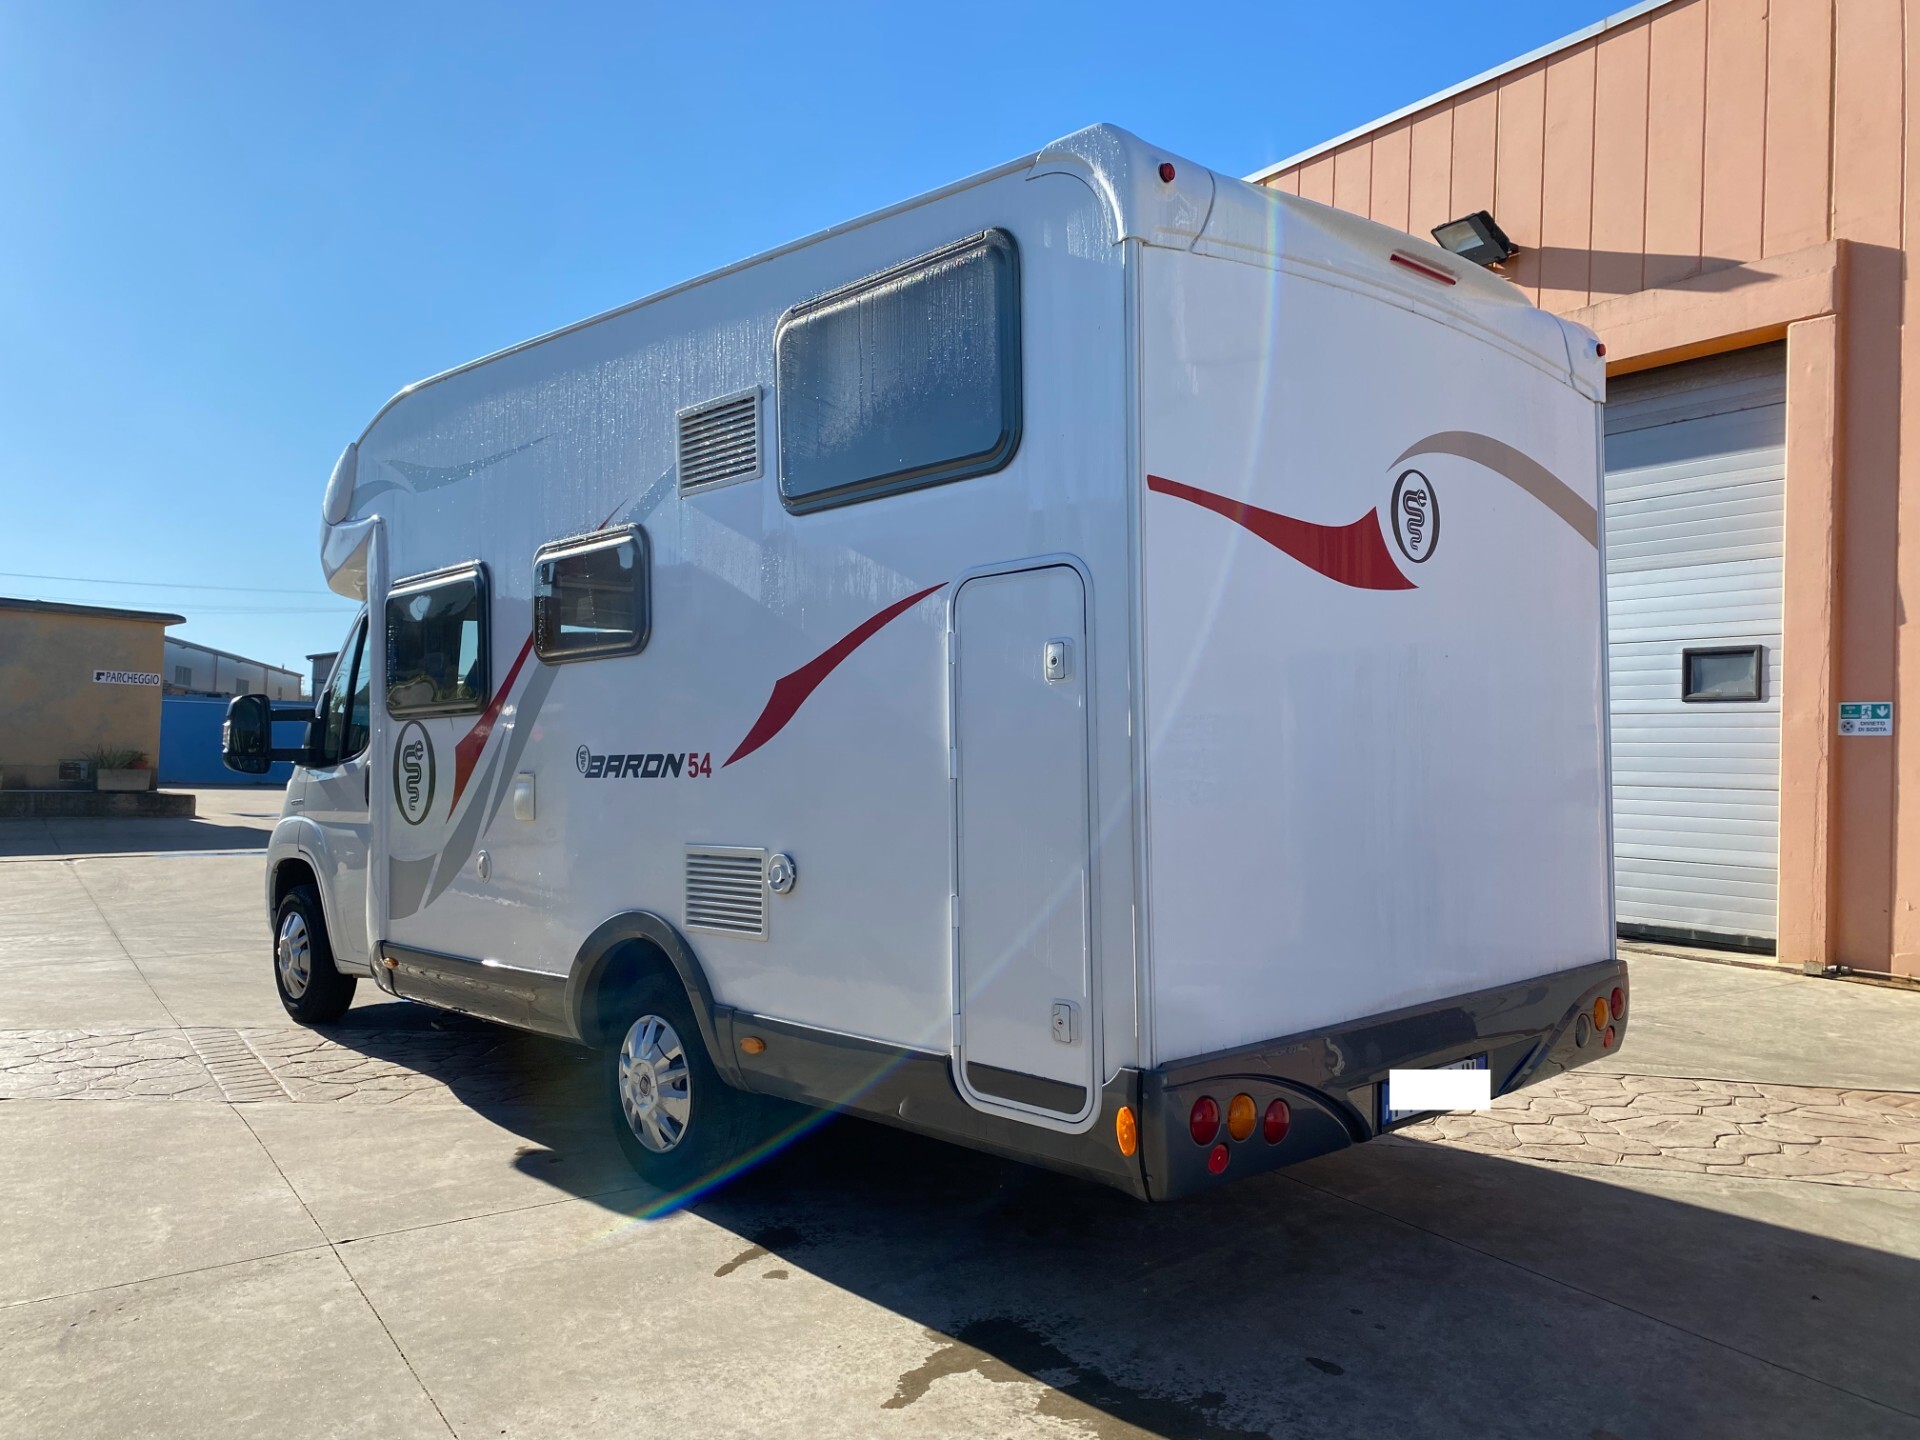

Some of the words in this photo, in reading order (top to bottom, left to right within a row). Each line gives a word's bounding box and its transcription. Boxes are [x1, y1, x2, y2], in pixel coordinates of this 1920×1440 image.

[105, 671, 160, 685] PARCHEGGIO
[585, 753, 686, 778] BARON
[688, 752, 712, 778] 54
